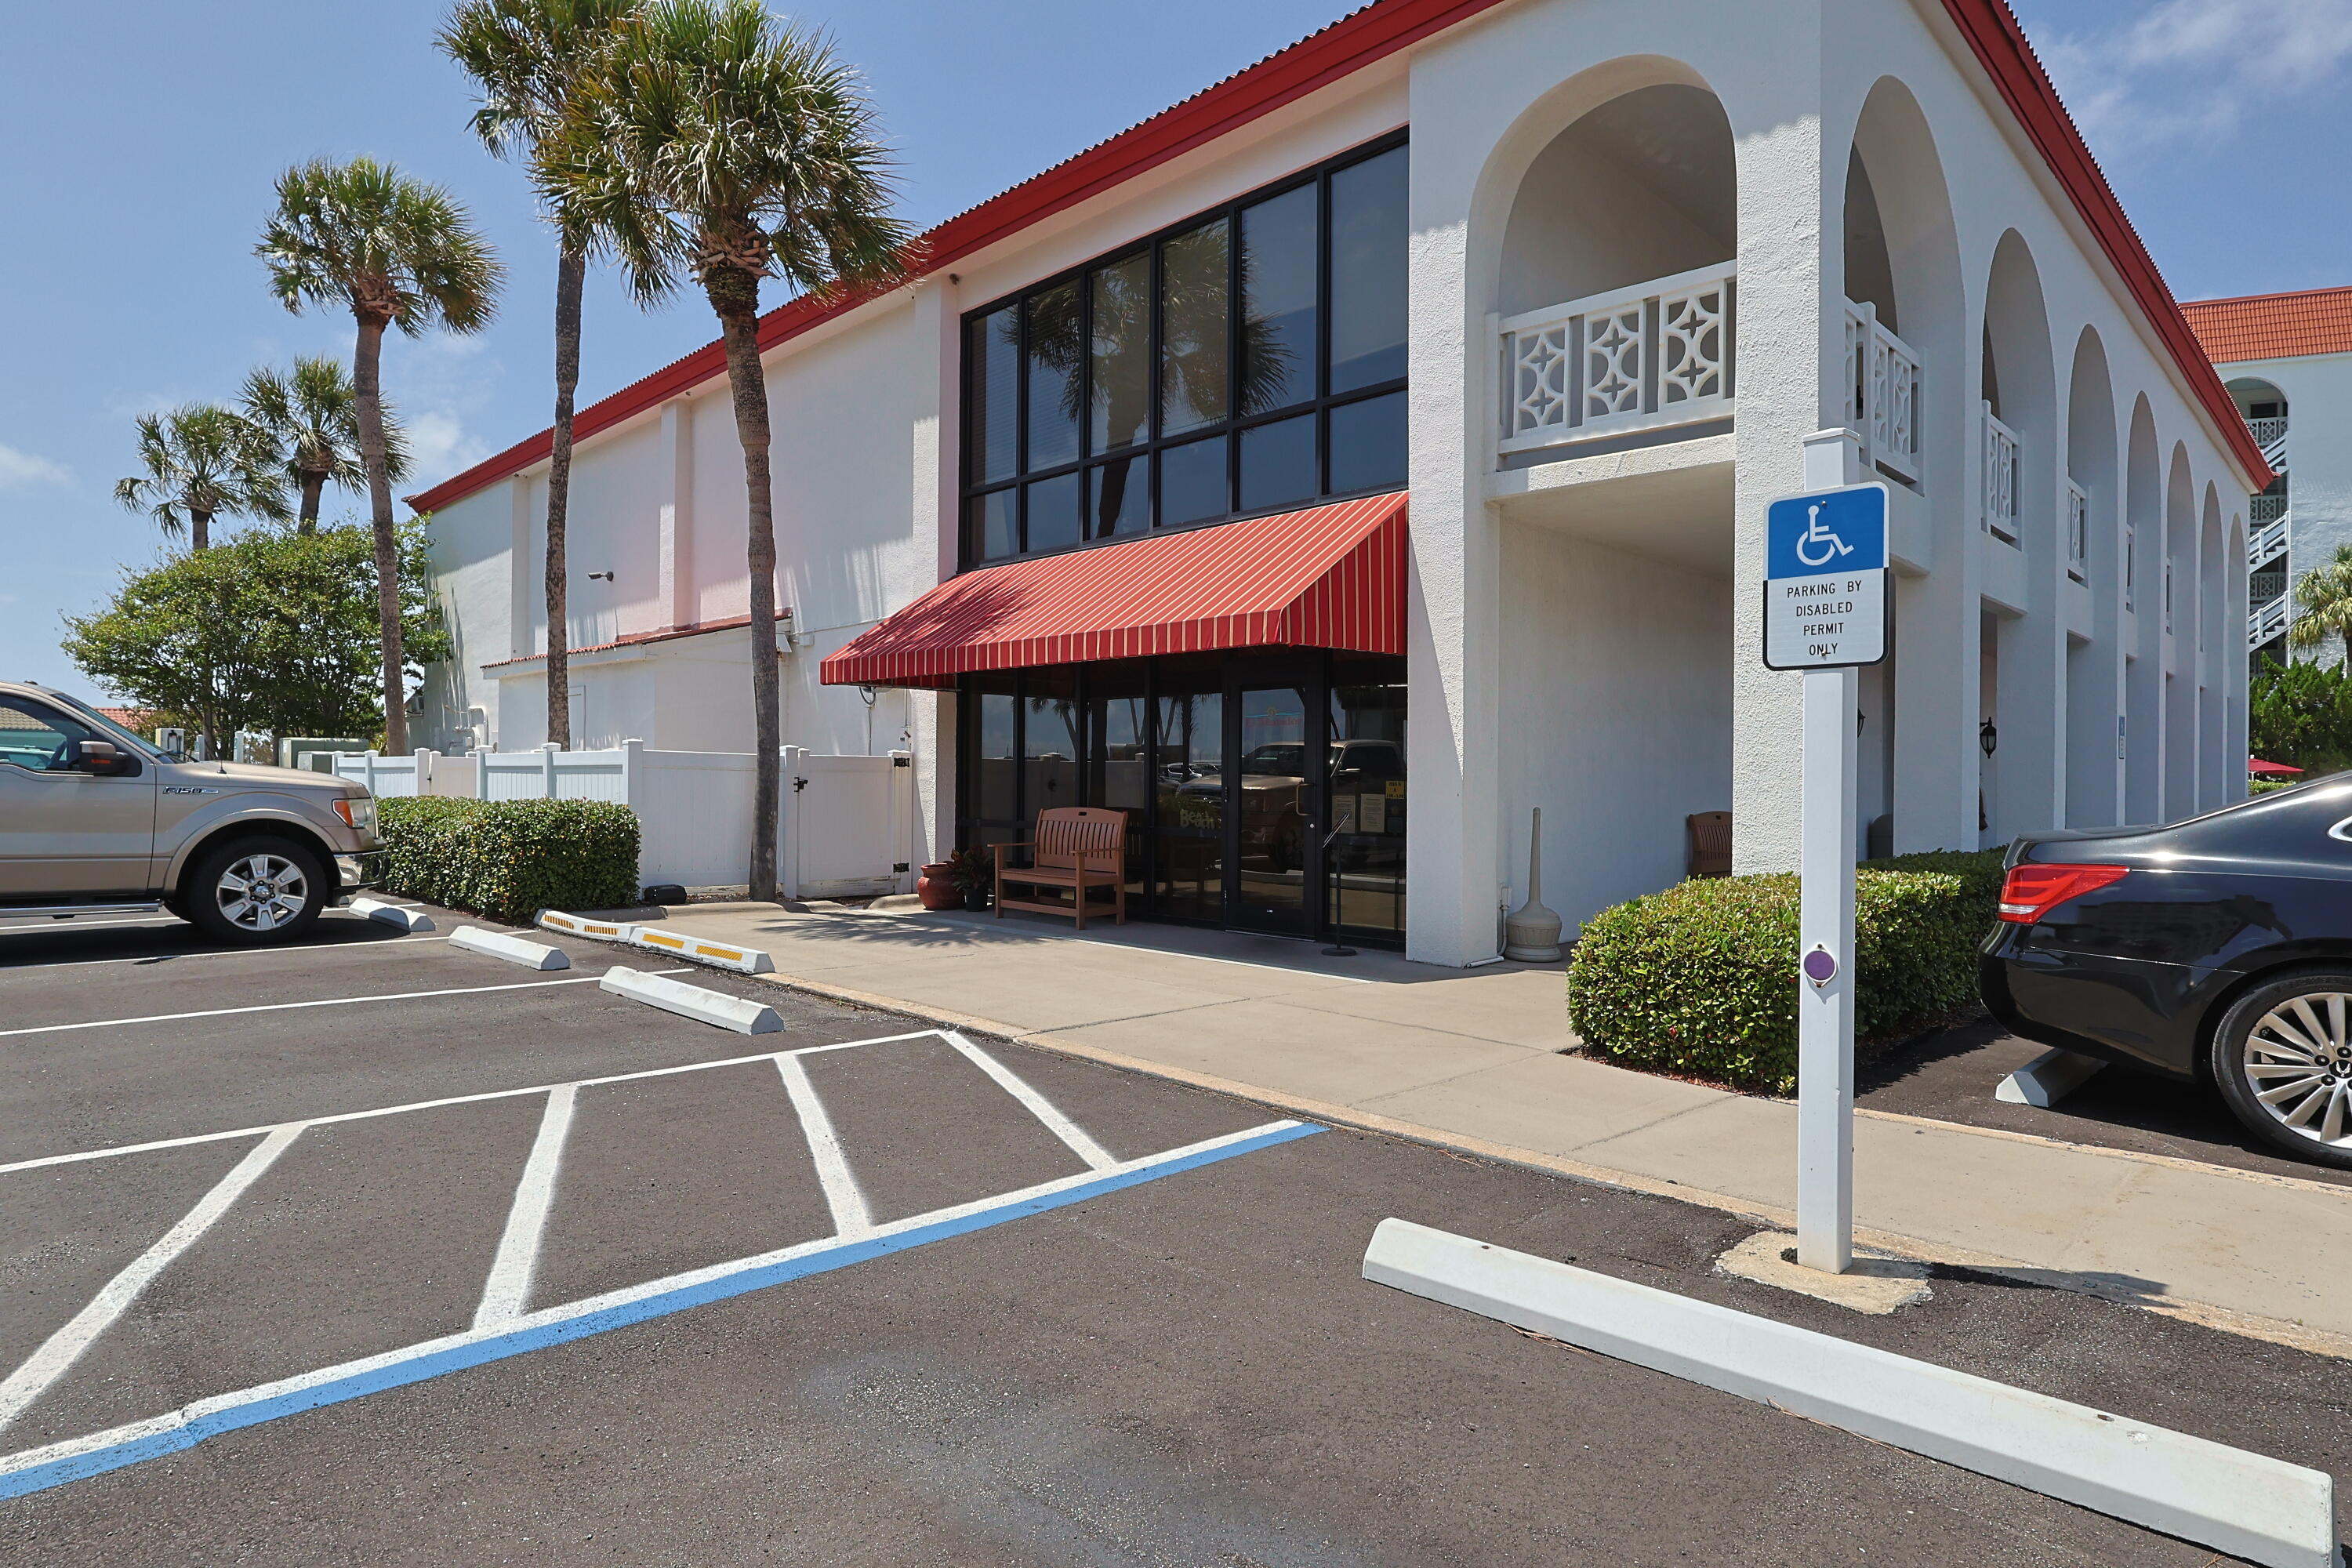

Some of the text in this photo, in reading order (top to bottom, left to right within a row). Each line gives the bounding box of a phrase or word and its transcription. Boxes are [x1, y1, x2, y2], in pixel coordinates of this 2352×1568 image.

[1787, 580, 1862, 598] PARKING BY
[1796, 601, 1853, 617] DISABLED
[1803, 622, 1844, 636] PERMIT
[1809, 643, 1838, 655] ONLY
